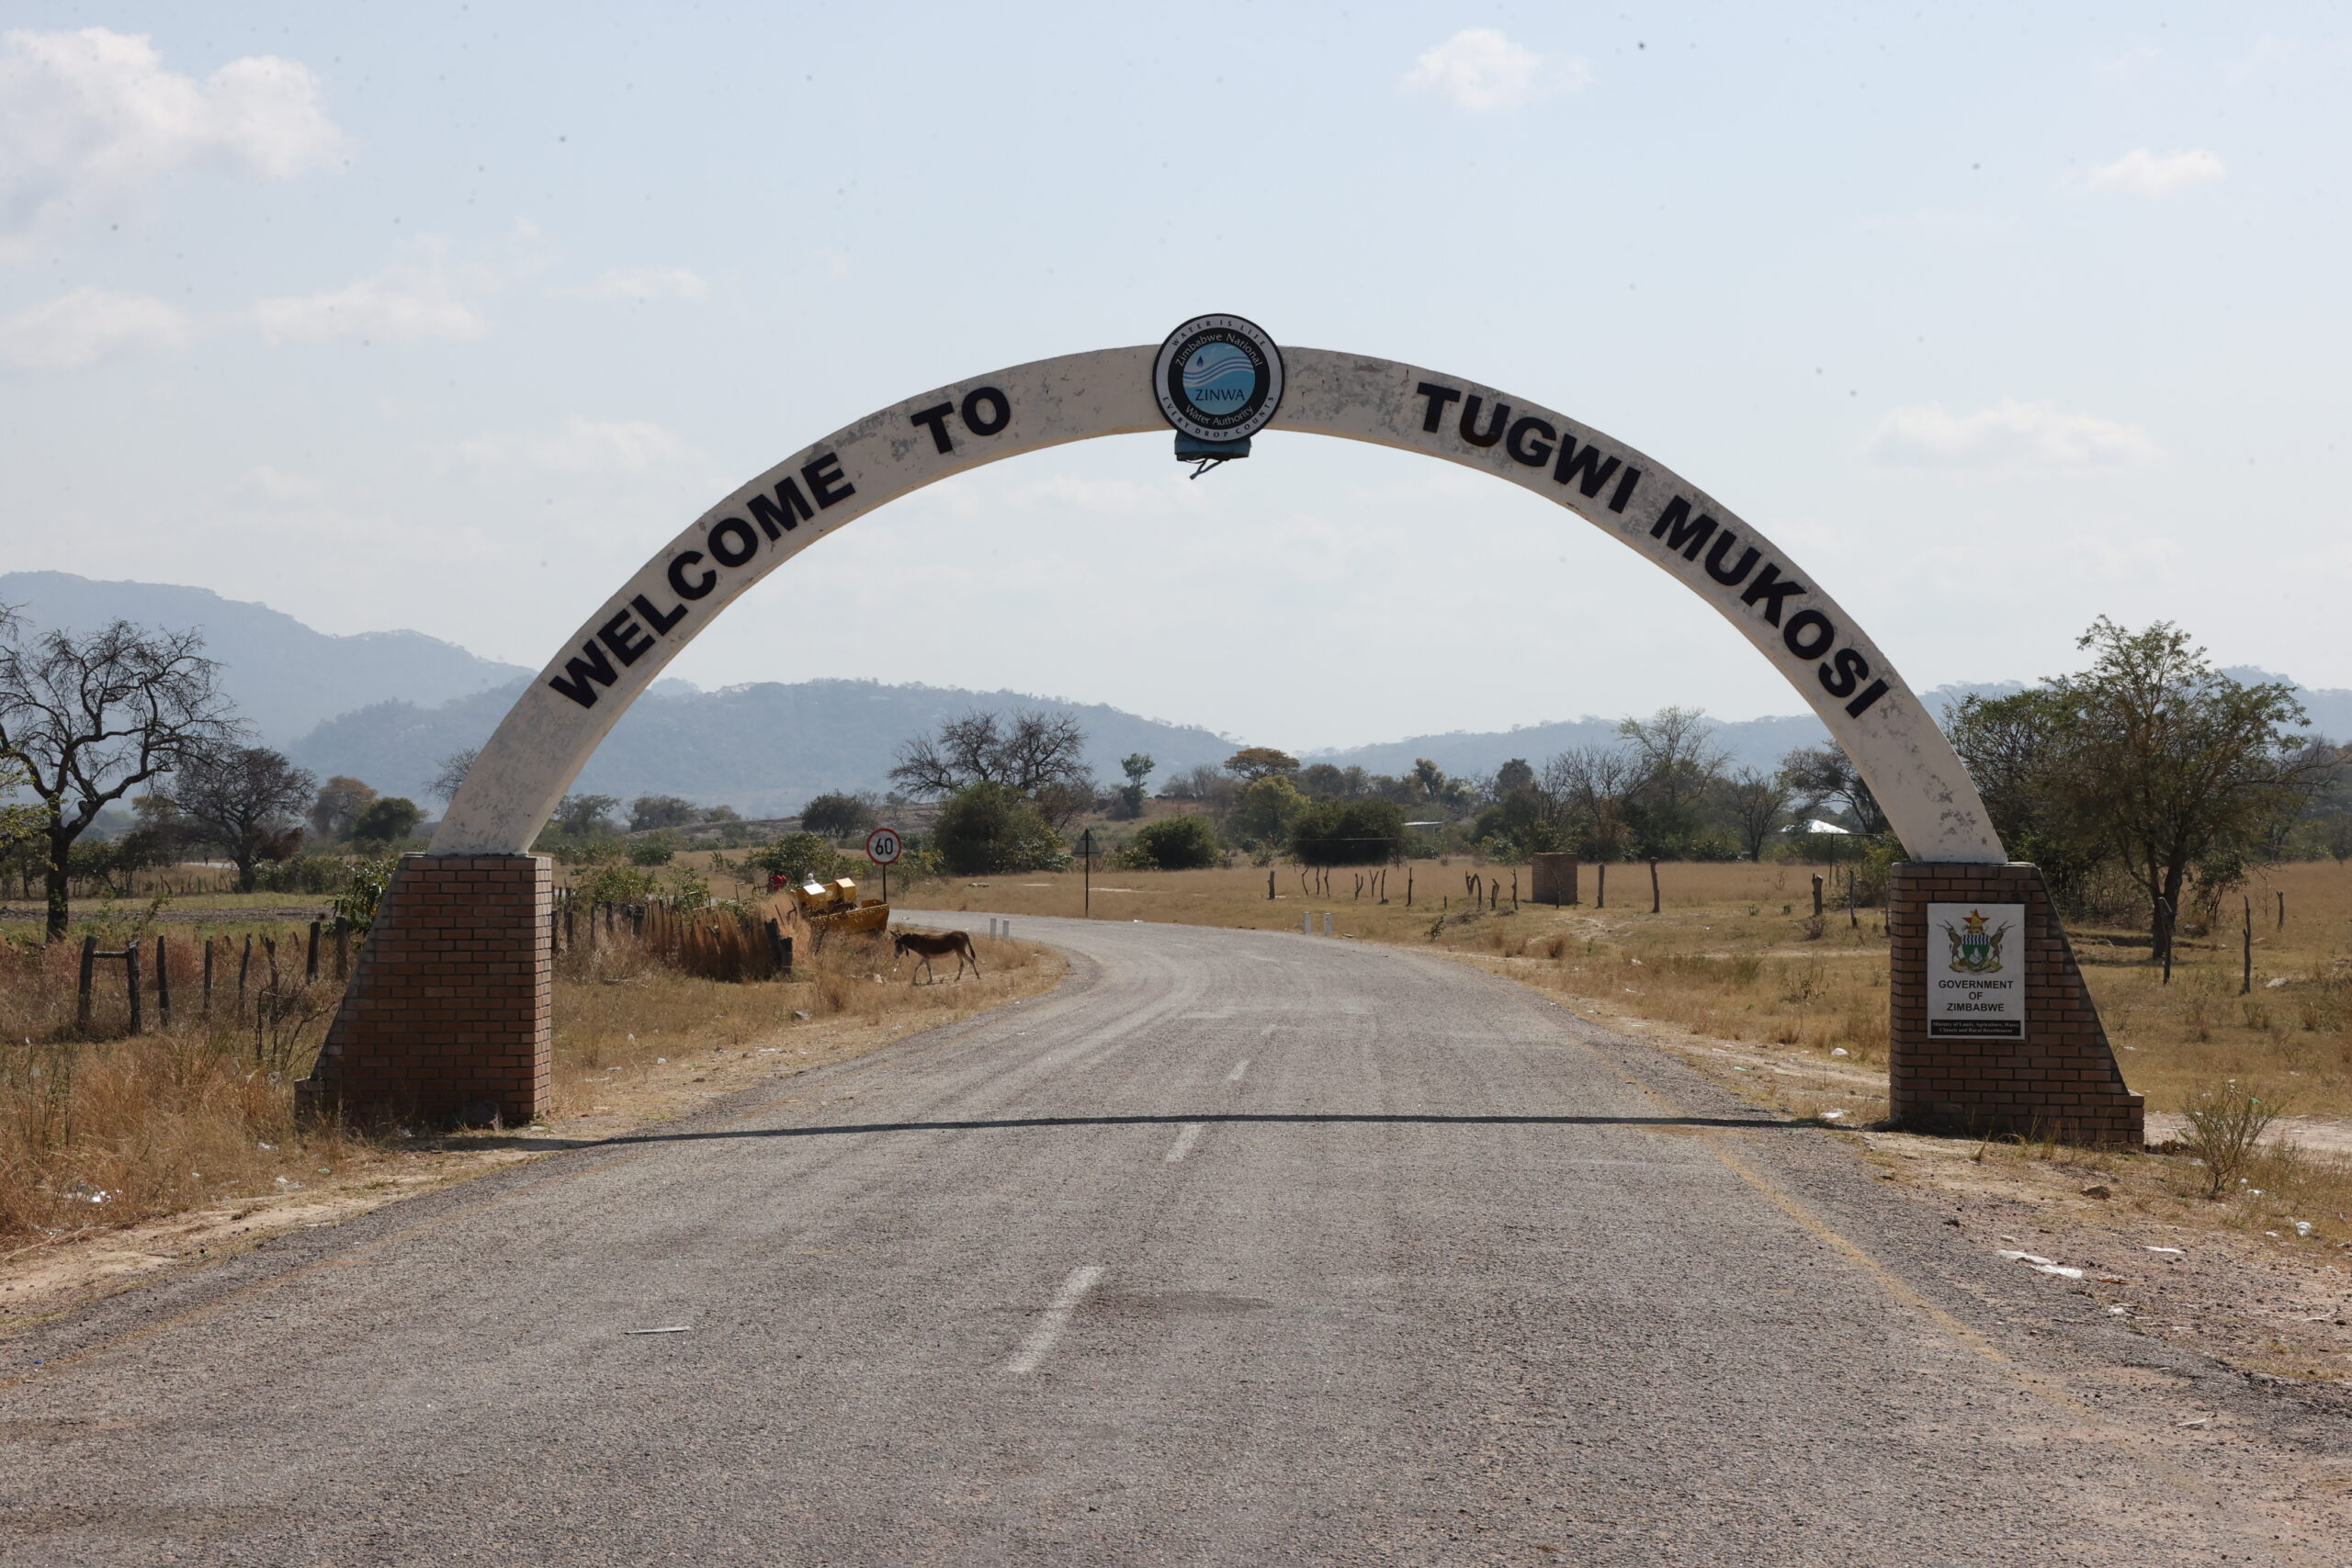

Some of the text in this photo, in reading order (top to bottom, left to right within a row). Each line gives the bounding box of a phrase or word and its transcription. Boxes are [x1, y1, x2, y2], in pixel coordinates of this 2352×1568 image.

[1172, 320, 1212, 347] WATER
[1240, 324, 1266, 347] LIFE
[1175, 333, 1263, 367] Zimbabwe National
[1195, 389, 1246, 400] ZINWA
[1162, 396, 1274, 437] EVERY DROP COUNTS
[1185, 404, 1253, 426] Water Authority
[548, 381, 1890, 719] WELCOME TO TUGWI MUKOSI
[875, 838, 893, 856] 60
[1939, 979, 2014, 989] GOVERNMENT
[1947, 1003, 2005, 1011] ZIMBABWE
